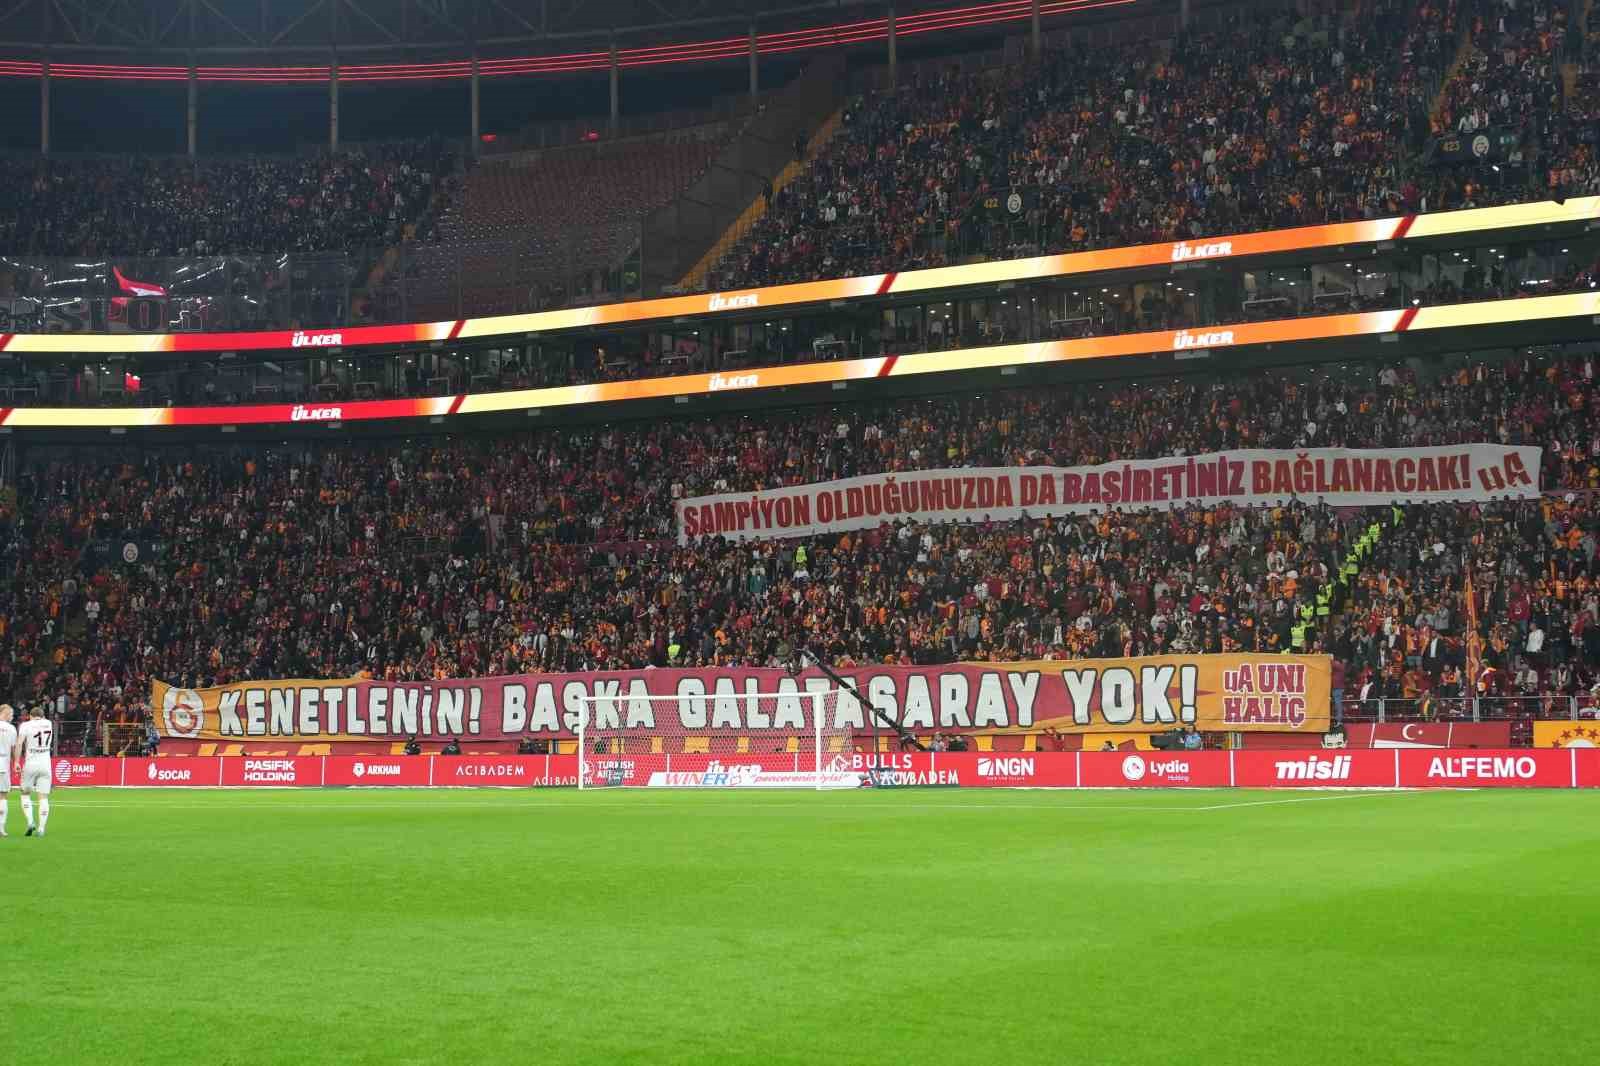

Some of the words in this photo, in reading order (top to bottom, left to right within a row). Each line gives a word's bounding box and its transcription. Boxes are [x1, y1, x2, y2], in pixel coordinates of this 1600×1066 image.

[1172, 241, 1232, 262] ÜLKER
[709, 293, 758, 311] ÜLKER
[292, 331, 342, 347] ÜLKER
[1174, 329, 1234, 350] ÜLKER
[709, 373, 758, 391] ÜLKER
[291, 405, 342, 421] ÜLKER
[816, 475, 1013, 524] OLDUĞUMUZDA
[1020, 473, 1057, 507] DA
[1063, 455, 1246, 505] BASİRETİNİZ
[1252, 452, 1472, 495] BAĞLANACAK!
[1062, 664, 1199, 726] YOK!
[33, 730, 52, 746] 17
[852, 754, 912, 769] BULLS
[995, 758, 1034, 777] NGN
[1150, 759, 1190, 777] Lydia
[1275, 755, 1352, 780] misli
[1427, 757, 1536, 779] ALFEMO
[158, 769, 191, 781] SOCAR
[455, 765, 525, 777] ACIBADEM
